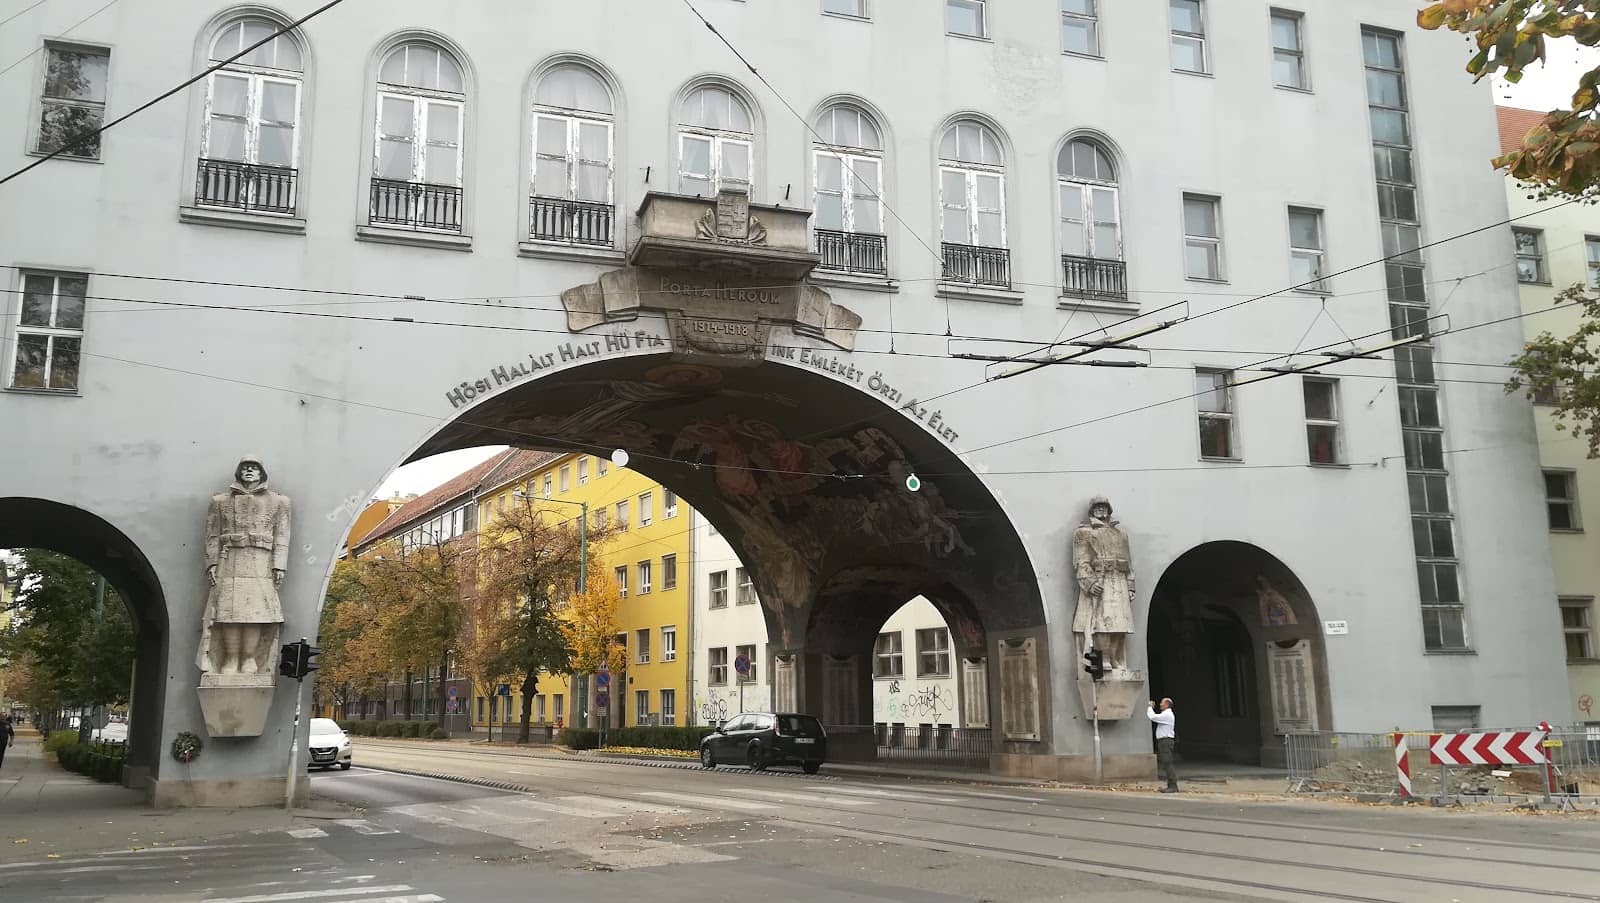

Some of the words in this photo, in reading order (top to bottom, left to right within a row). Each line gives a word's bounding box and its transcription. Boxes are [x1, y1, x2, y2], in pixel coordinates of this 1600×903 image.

[693, 320, 749, 337] 1914-1918
[557, 341, 600, 363] HALT
[902, 398, 928, 420] AZ
[927, 410, 960, 444] ÉLET
